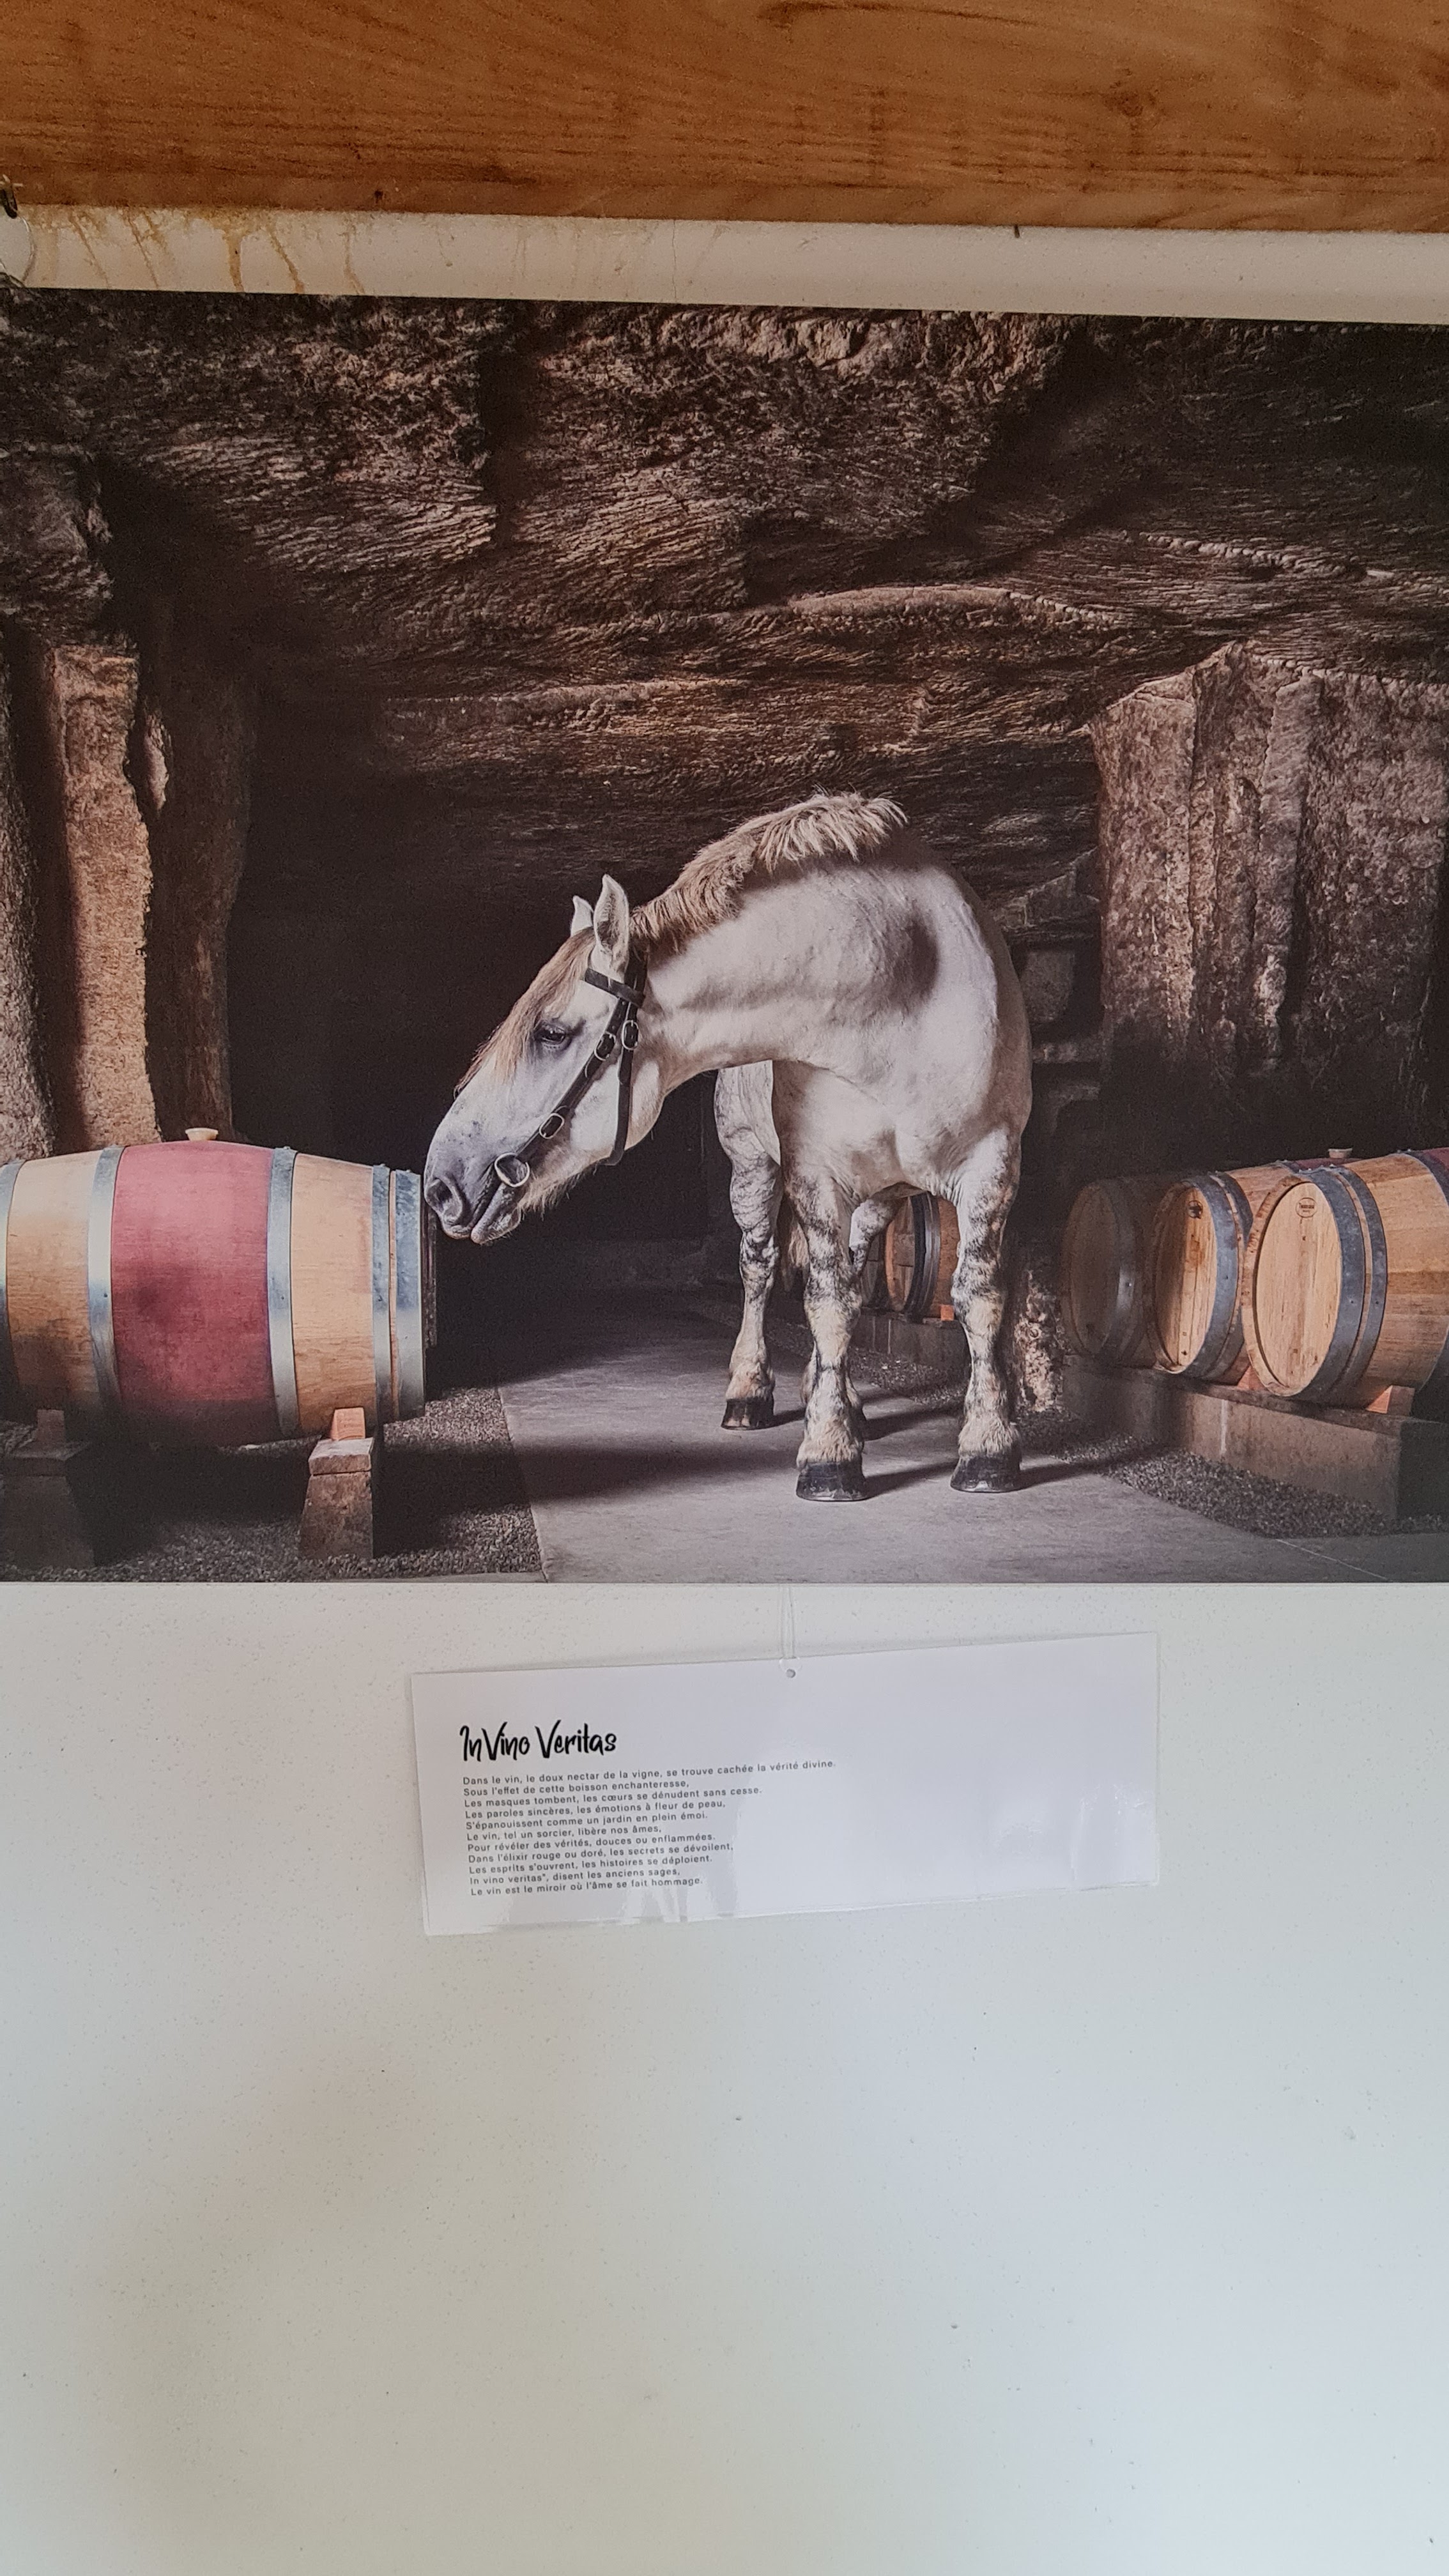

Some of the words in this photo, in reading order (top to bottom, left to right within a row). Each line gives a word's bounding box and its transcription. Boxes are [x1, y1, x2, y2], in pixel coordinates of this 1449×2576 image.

[459, 1726, 481, 1762] In
[481, 1722, 530, 1761] Vino
[535, 1720, 617, 1759] Veritas
[463, 1777, 489, 1785] Dans
[492, 1775, 501, 1784] le
[504, 1775, 523, 1784] vin,
[526, 1774, 535, 1783] le
[539, 1774, 564, 1782] doux
[567, 1772, 599, 1781] nectar
[603, 1771, 615, 1779] de
[619, 1770, 628, 1779] la
[632, 1770, 663, 1780] vigne,
[681, 1768, 714, 1776] trouve
[717, 1764, 753, 1774] cachée
[757, 1763, 766, 1772] la
[769, 1761, 799, 1771] vérité
[802, 1760, 836, 1769] divine.
[463, 1788, 488, 1797] Sous
[491, 1786, 519, 1795] l'effet
[523, 1786, 535, 1794] de
[539, 1785, 565, 1793] cette
[569, 1782, 608, 1792] boisson
[611, 1781, 689, 1791] enchanteresse,
[464, 1799, 482, 1808] Les
[486, 1798, 530, 1807] masques
[534, 1795, 579, 1805] tombent,
[583, 1794, 597, 1802] les
[601, 1794, 633, 1802] cœurs
[651, 1790, 700, 1800] dénudent
[465, 1811, 483, 1819] Les
[486, 1808, 524, 1820] paroles
[527, 1806, 573, 1816] sincères,
[577, 1805, 592, 1814] les
[595, 1804, 641, 1813] émotions
[645, 1802, 651, 1811] à
[655, 1802, 678, 1811] fleur
[682, 1801, 694, 1809] de
[698, 1800, 725, 1810] peau,
[466, 1819, 543, 1830] S'épanouissent
[547, 1818, 583, 1827] comme
[602, 1814, 632, 1826] jardin
[652, 1813, 677, 1823] plein
[680, 1811, 707, 1820] émoi.
[466, 1833, 479, 1841] Le
[482, 1832, 500, 1841] vin,
[503, 1830, 517, 1840] tel
[537, 1828, 574, 1838] sorcier,
[578, 1827, 607, 1836] libère
[611, 1827, 629, 1835] nos
[632, 1825, 661, 1834] âmes,
[468, 1844, 491, 1852] Pour
[494, 1841, 530, 1851] révéler
[533, 1841, 551, 1849] des
[554, 1838, 592, 1848] vérités,
[595, 1837, 632, 1846] douces
[652, 1834, 716, 1844] enflammées.
[468, 1855, 494, 1864] Dans
[497, 1852, 528, 1862] l'élixir
[532, 1852, 561, 1861] rouge
[580, 1848, 606, 1858] doré,
[610, 1848, 624, 1856] les
[627, 1846, 664, 1855] secrets
[683, 1843, 733, 1853] dévoilent,
[469, 1866, 487, 1874] Les
[490, 1863, 525, 1874] esprits
[528, 1862, 578, 1871] s'ouvrent,
[581, 1860, 596, 1869] les
[600, 1858, 643, 1867] histoires
[662, 1855, 712, 1866] déploient.
[470, 1877, 479, 1885] In
[482, 1876, 504, 1884] vino
[553, 1872, 583, 1881] disent
[587, 1871, 602, 1879] les
[606, 1869, 644, 1878] anciens
[648, 1868, 680, 1878] sages,
[486, 1887, 501, 1895] vin
[505, 1886, 520, 1894] est
[524, 1885, 533, 1893] le
[537, 1883, 566, 1892] miroir
[570, 1882, 583, 1890] où
[586, 1881, 613, 1890] l'âme
[631, 1879, 648, 1887] fait
[651, 1878, 703, 1887] hommage.
